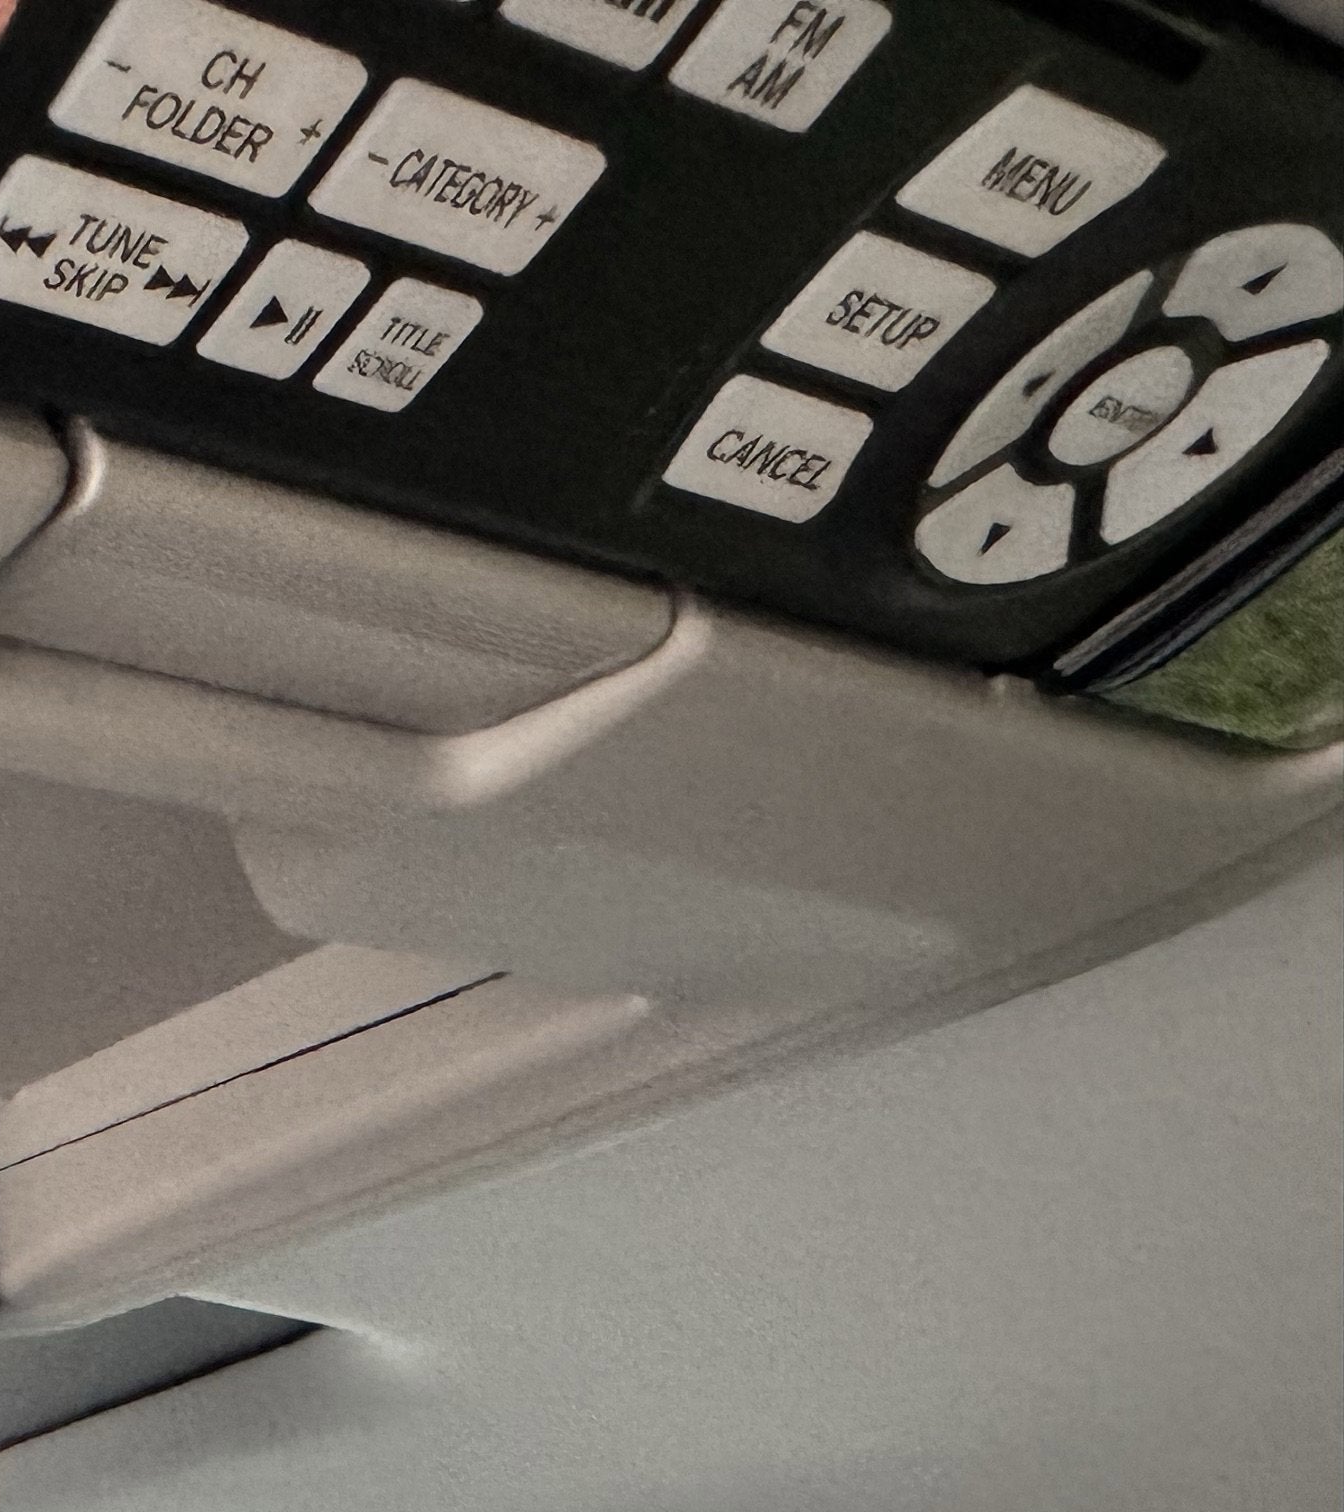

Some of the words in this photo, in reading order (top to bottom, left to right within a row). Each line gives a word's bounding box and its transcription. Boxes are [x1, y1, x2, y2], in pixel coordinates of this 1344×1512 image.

[768, 1, 846, 59] FM
[201, 50, 266, 99] CH
[725, 52, 806, 109] AM
[120, 84, 274, 163] FOLDER
[981, 147, 1092, 216] MENU
[68, 213, 169, 269] TUNE
[42, 258, 129, 301] SKIP
[380, 316, 451, 356] TITLE
[825, 290, 940, 349] SETUP
[706, 429, 833, 491] CANCEL
